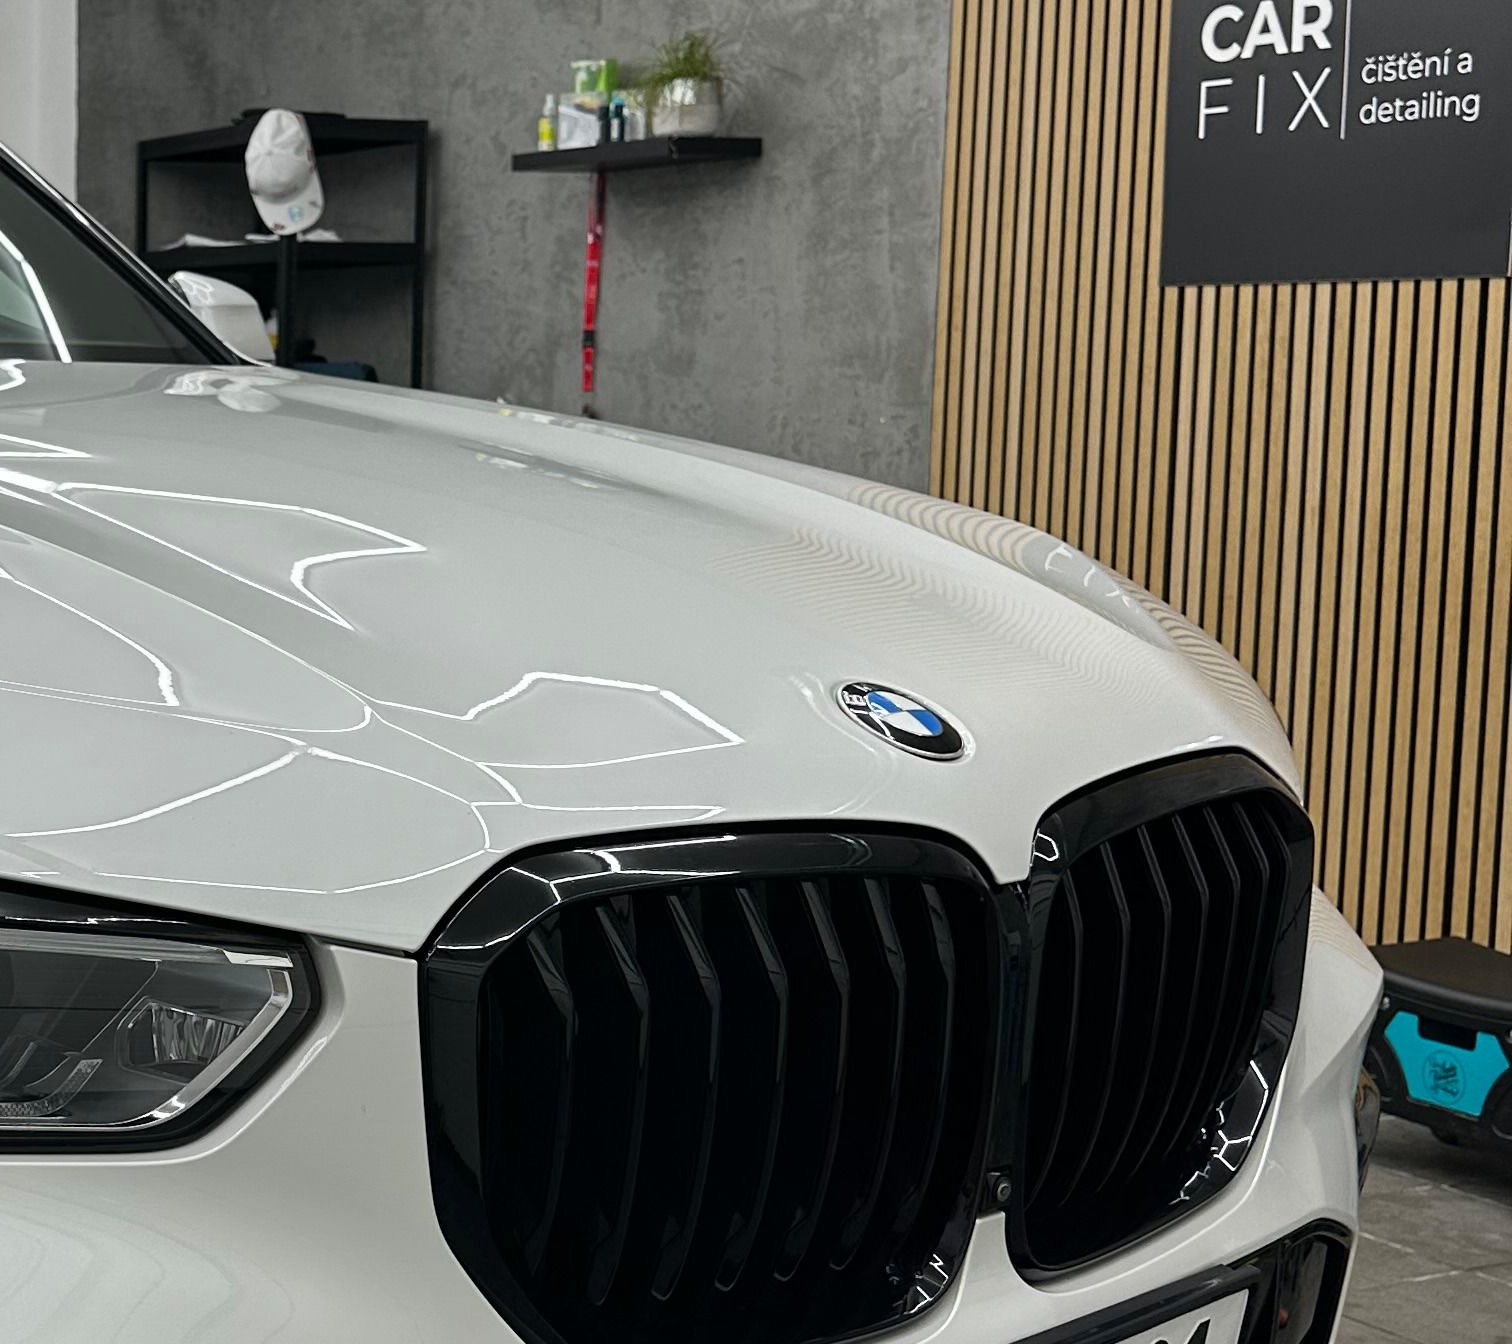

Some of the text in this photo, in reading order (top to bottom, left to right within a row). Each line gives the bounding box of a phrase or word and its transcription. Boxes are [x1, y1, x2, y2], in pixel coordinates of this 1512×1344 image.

[1360, 48, 1473, 85] čištění a
[1197, 67, 1331, 139] FIX
[1358, 90, 1480, 124] detailing
